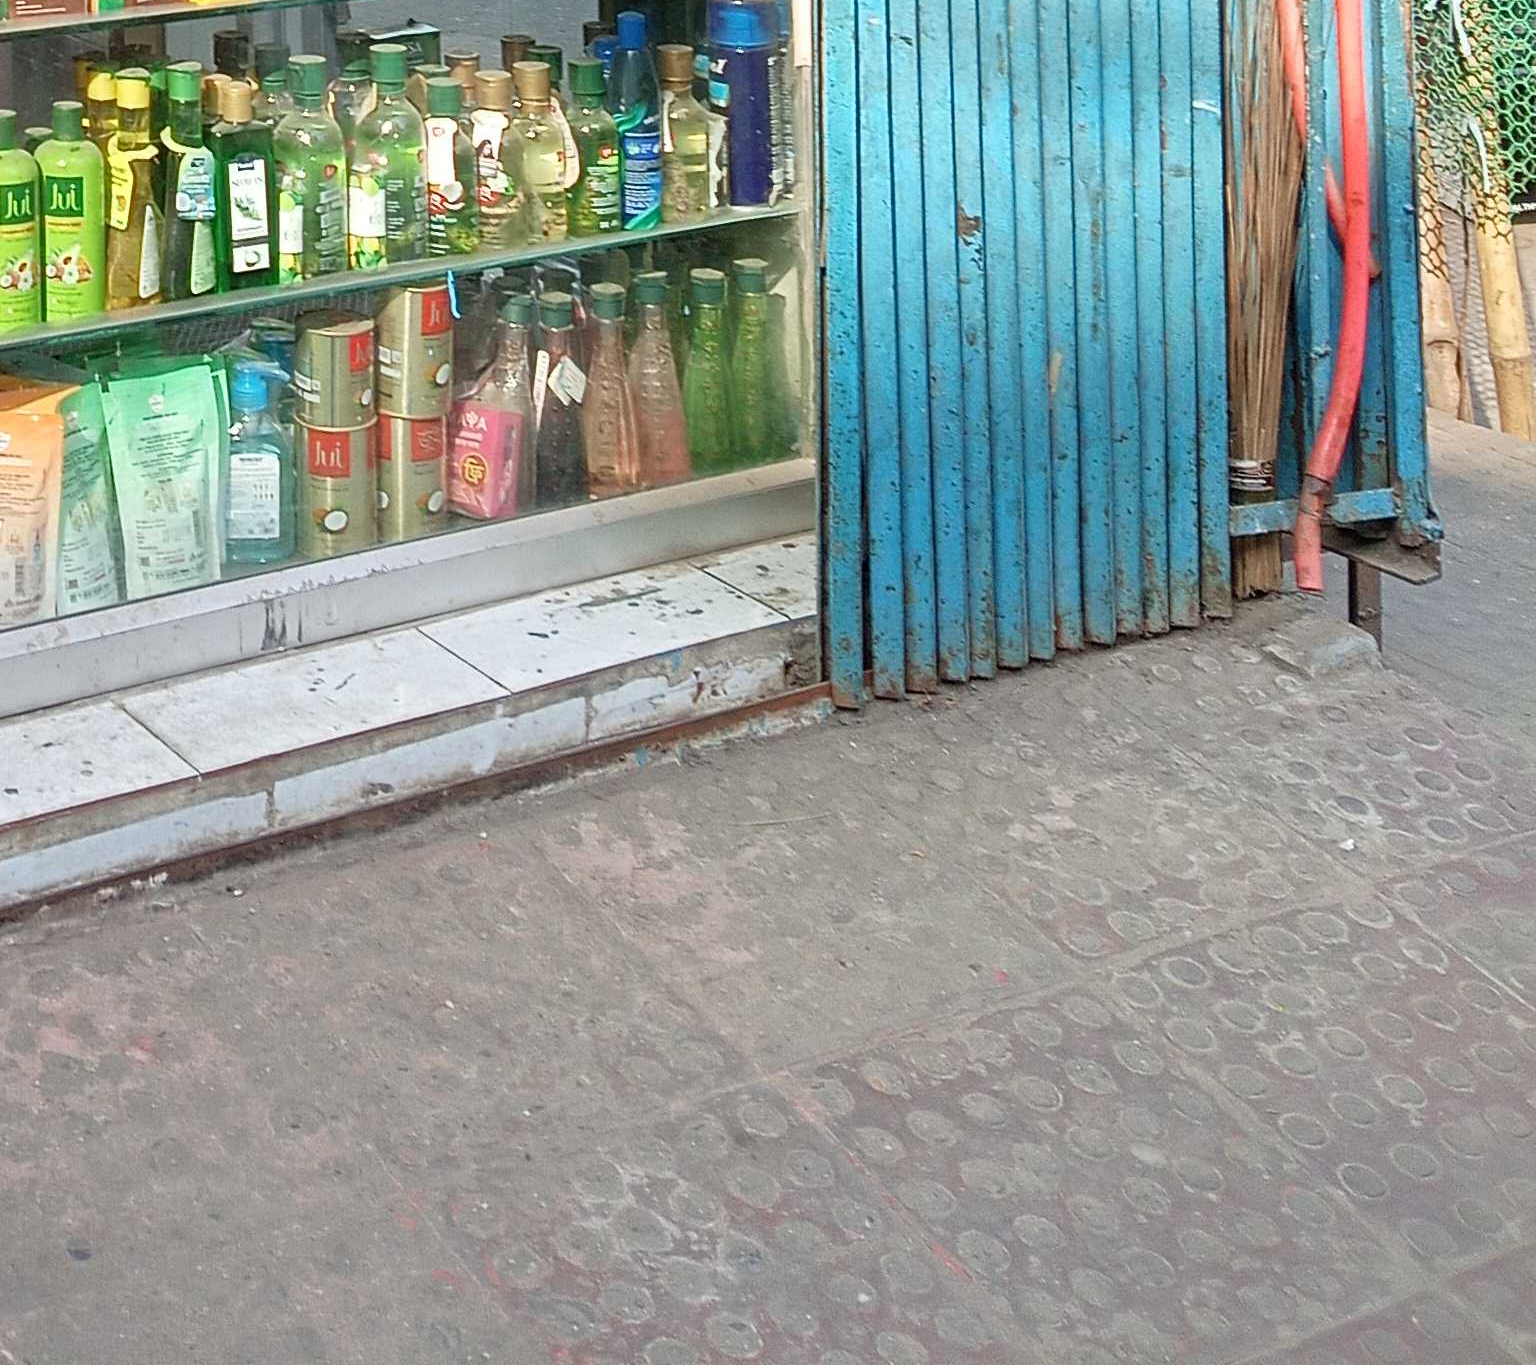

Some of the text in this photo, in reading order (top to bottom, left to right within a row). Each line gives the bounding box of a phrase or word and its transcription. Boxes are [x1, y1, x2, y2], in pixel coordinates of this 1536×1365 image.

[3, 188, 32, 220] Jui
[50, 181, 78, 211] Jui
[314, 440, 343, 469] Jui
